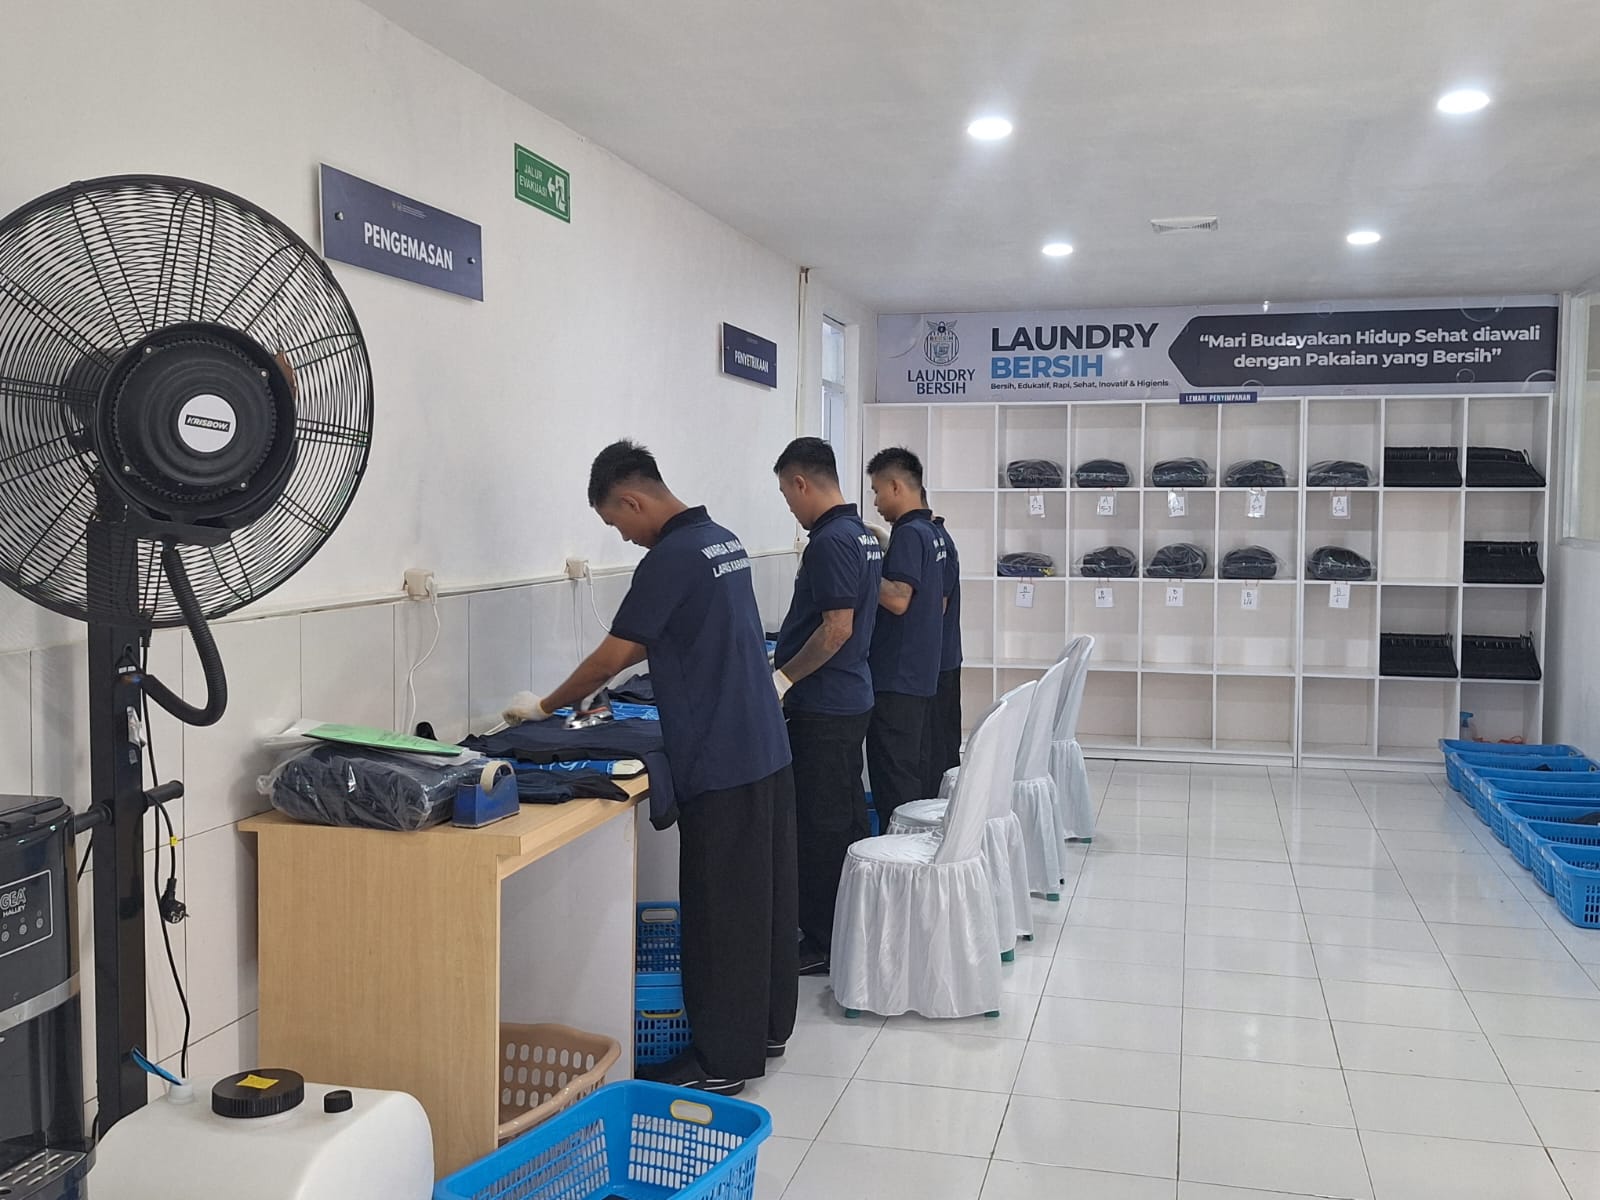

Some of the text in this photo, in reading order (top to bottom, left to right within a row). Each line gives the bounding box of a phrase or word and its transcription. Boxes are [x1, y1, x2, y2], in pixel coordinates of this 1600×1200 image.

[524, 164, 543, 181] JALUR
[519, 174, 548, 197] EVAKUASI
[363, 222, 453, 271] PENGEMASAN
[991, 323, 1159, 351] LAUNDRY
[1250, 331, 1351, 349] Budayakan
[1356, 329, 1411, 346] Hidup
[1414, 328, 1468, 343] Sehat
[1472, 325, 1541, 342] diawali
[734, 350, 769, 373] PENYETRIKAAN
[991, 354, 1103, 379] BERSIH
[1233, 354, 1301, 370] dengan
[1305, 350, 1378, 366] Pakaian
[1382, 352, 1428, 368] yang
[907, 368, 976, 382] LAUNDRY
[990, 382, 1016, 390] Bersih,
[1018, 381, 1051, 390] Edukatif,
[1053, 381, 1072, 390] Rapi,
[1073, 380, 1097, 389] Sehat,
[1099, 379, 1128, 388] Inovatif
[916, 381, 966, 395] BERSIH
[0, 889, 27, 910] GEA
